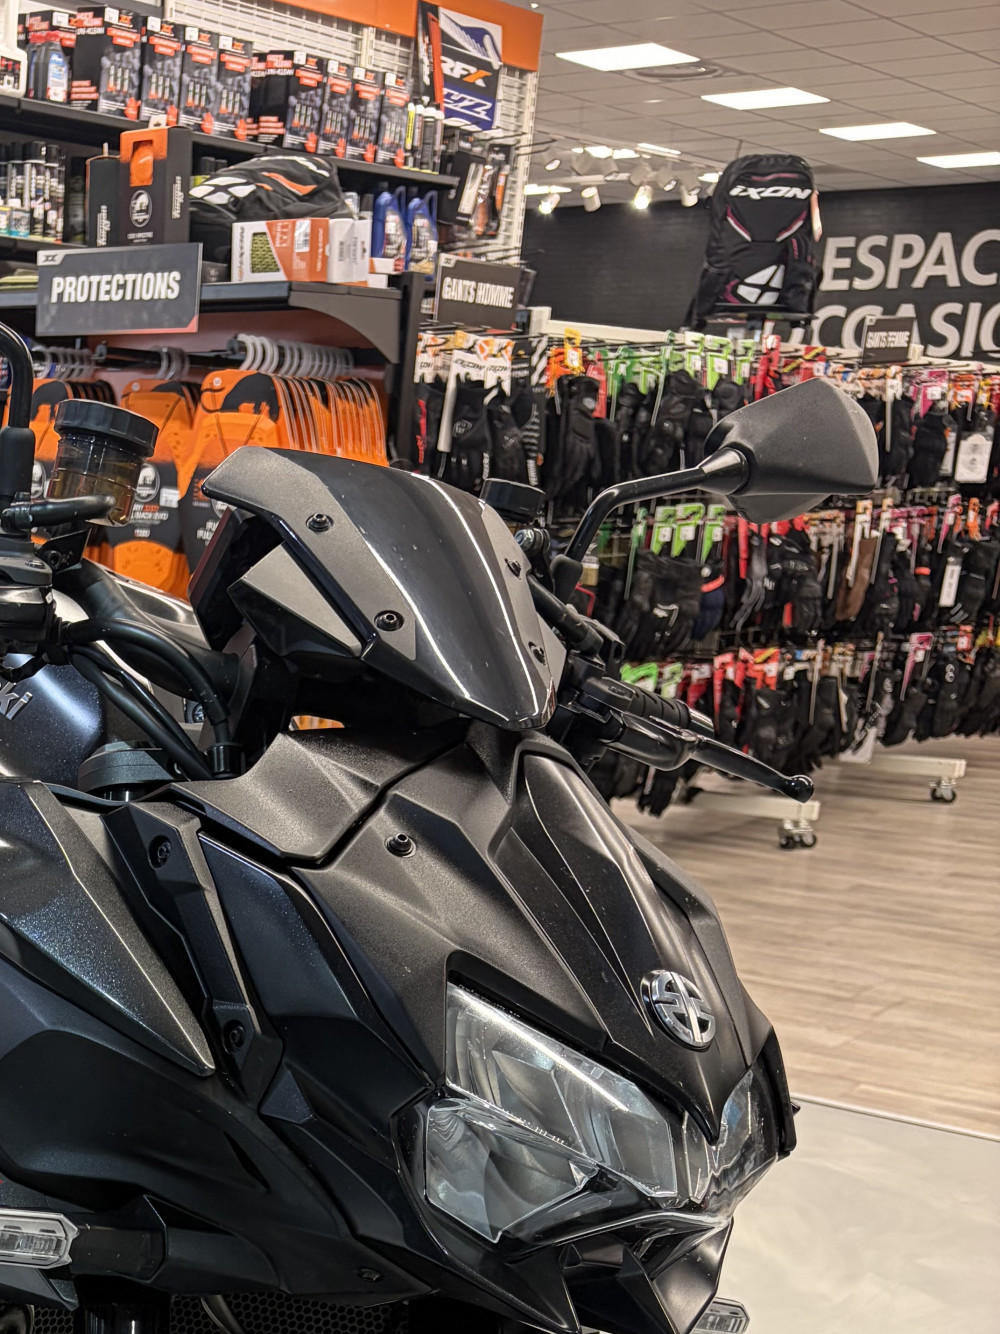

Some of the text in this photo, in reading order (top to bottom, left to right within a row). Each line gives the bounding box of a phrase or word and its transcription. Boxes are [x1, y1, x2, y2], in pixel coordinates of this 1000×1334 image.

[50, 272, 181, 302] PROTECTIONS
[441, 276, 515, 309] GANTS HOMME
